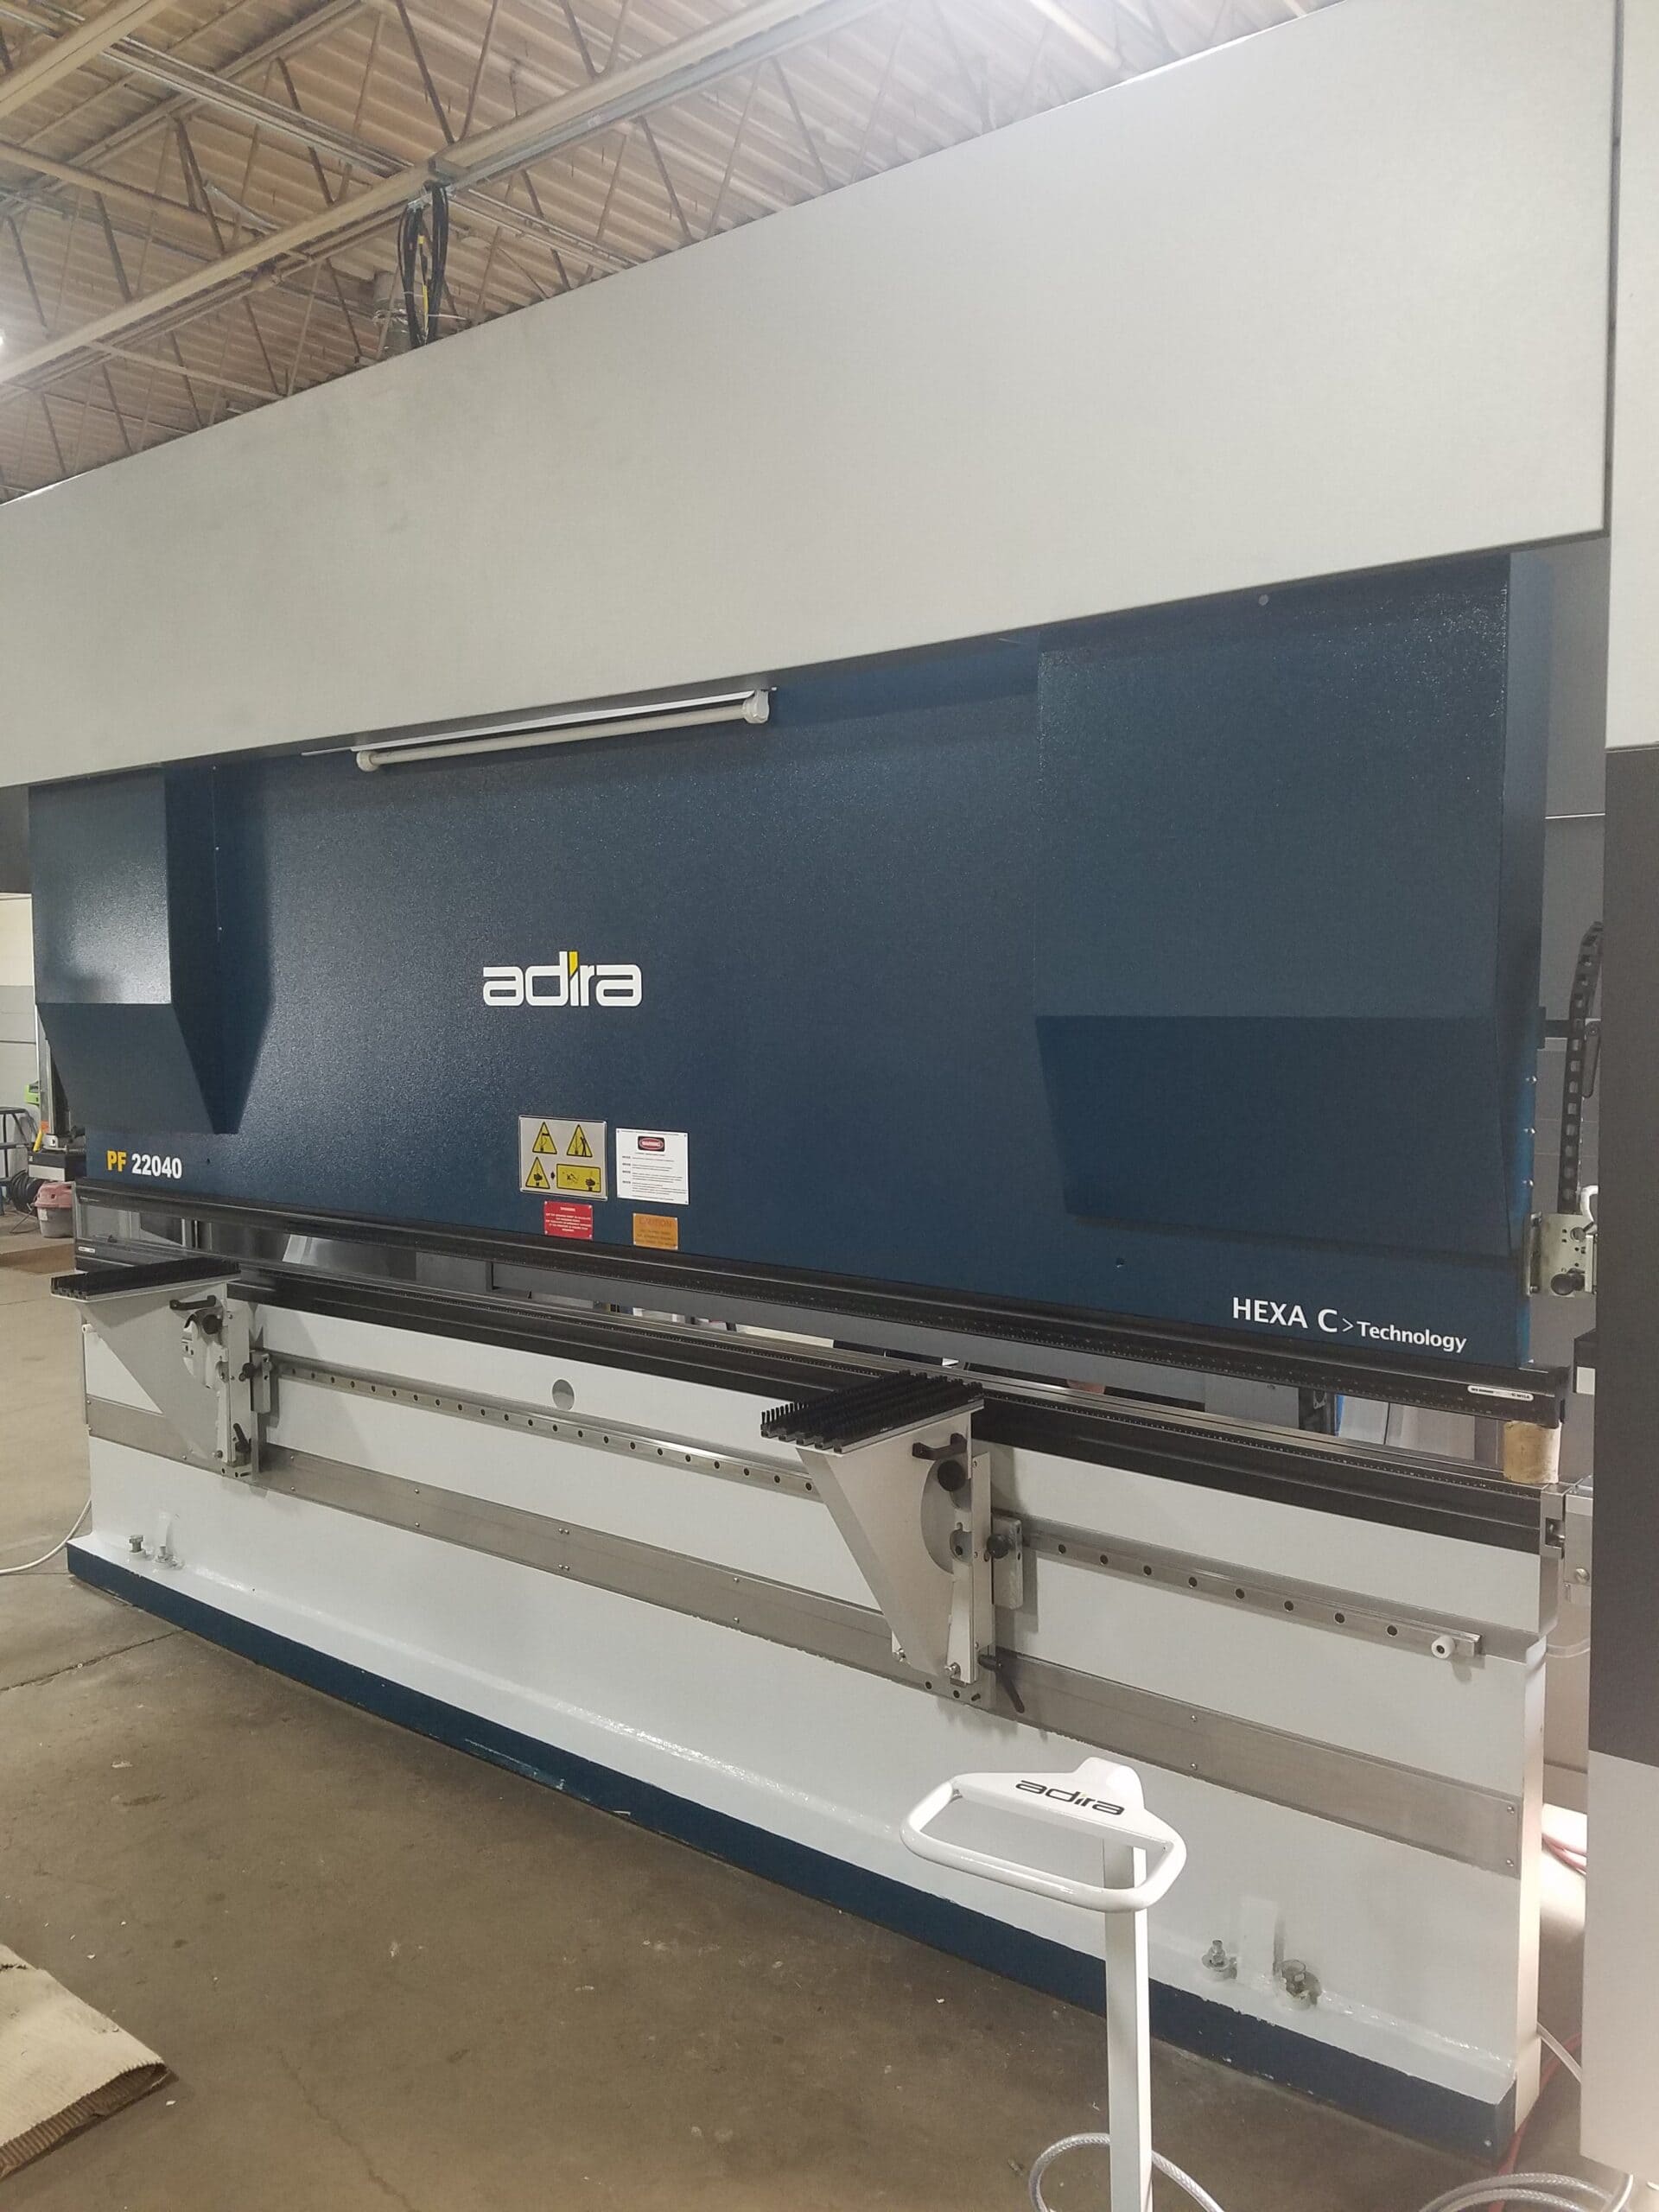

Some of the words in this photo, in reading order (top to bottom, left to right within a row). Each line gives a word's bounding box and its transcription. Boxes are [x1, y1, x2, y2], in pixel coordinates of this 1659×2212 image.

[482, 950, 643, 1007] adira
[106, 1150, 127, 1173] PF
[130, 1153, 182, 1179] 22040
[1232, 1296, 1308, 1329] HEXA
[1317, 1308, 1338, 1333] C
[1356, 1320, 1467, 1354] Technology
[1014, 1779, 1125, 1816] adira
